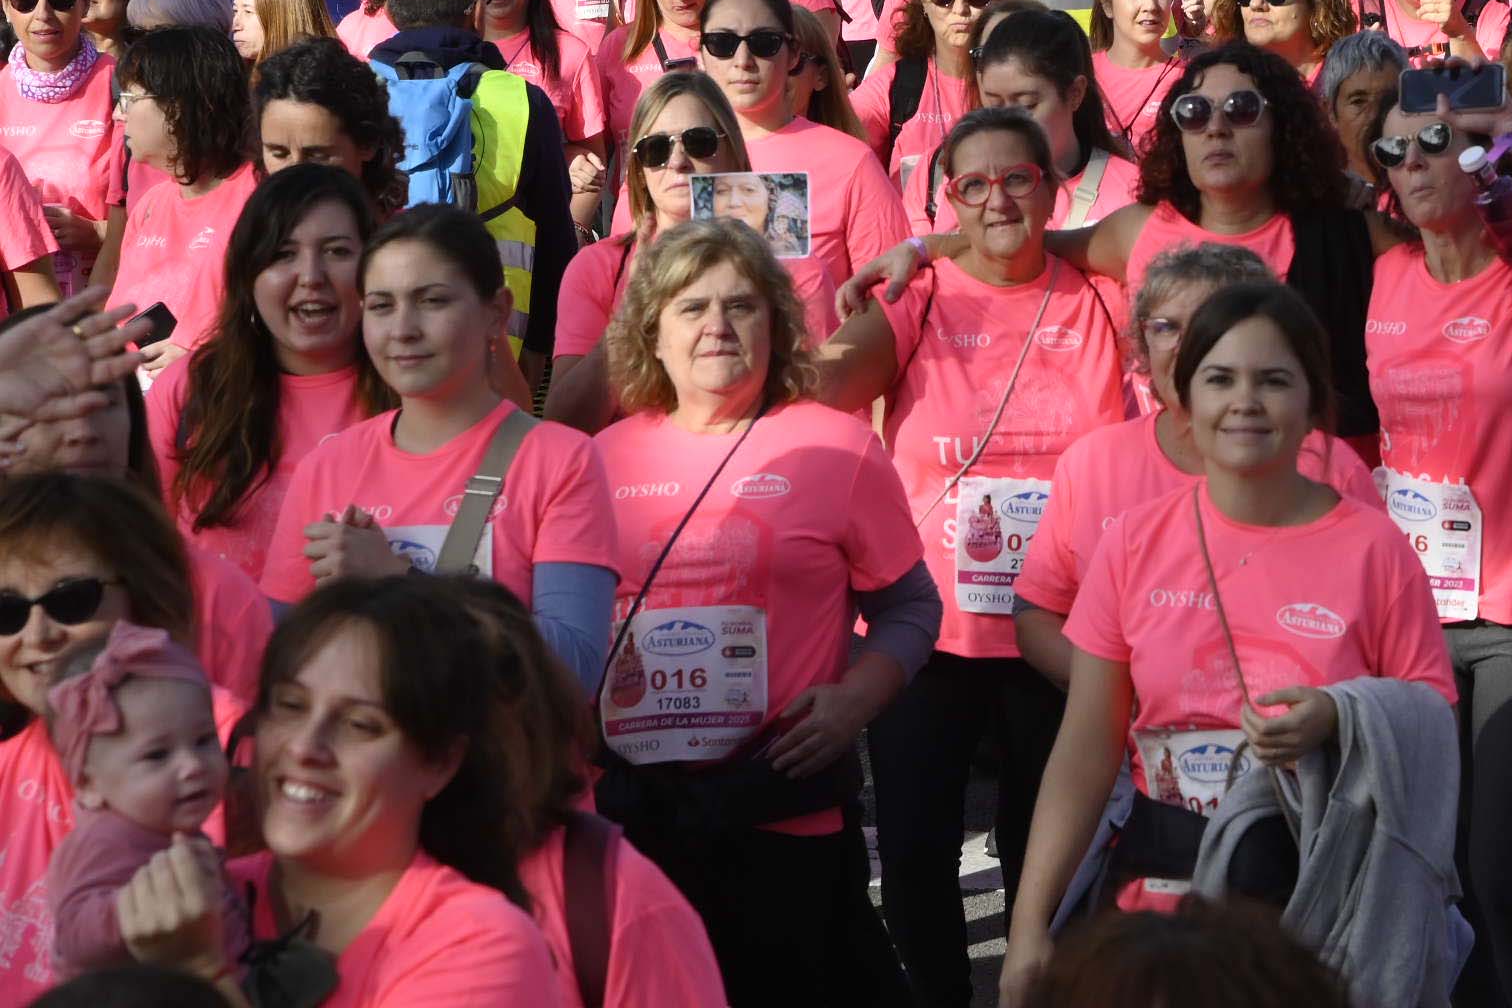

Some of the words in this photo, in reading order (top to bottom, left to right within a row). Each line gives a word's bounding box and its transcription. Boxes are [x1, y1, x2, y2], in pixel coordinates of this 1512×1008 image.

[937, 328, 991, 348] OSHO
[933, 435, 978, 465] TU
[616, 481, 681, 500] OYSHO
[1006, 502, 1042, 515] ASTURI
[972, 574, 1012, 583] CARRERA
[968, 592, 1012, 604] OYSHO
[1436, 598, 1466, 608] tander
[1281, 611, 1341, 634] ASTURIANA
[722, 626, 755, 635] SUMA
[647, 635, 710, 649] ASTURIANA
[651, 668, 707, 691] 016
[657, 696, 701, 710] 17083
[618, 720, 658, 731] CARRERA
[661, 718, 672, 727] DE
[677, 718, 688, 726] LA
[691, 716, 724, 725] MUJER
[617, 739, 660, 753] OYSHO
